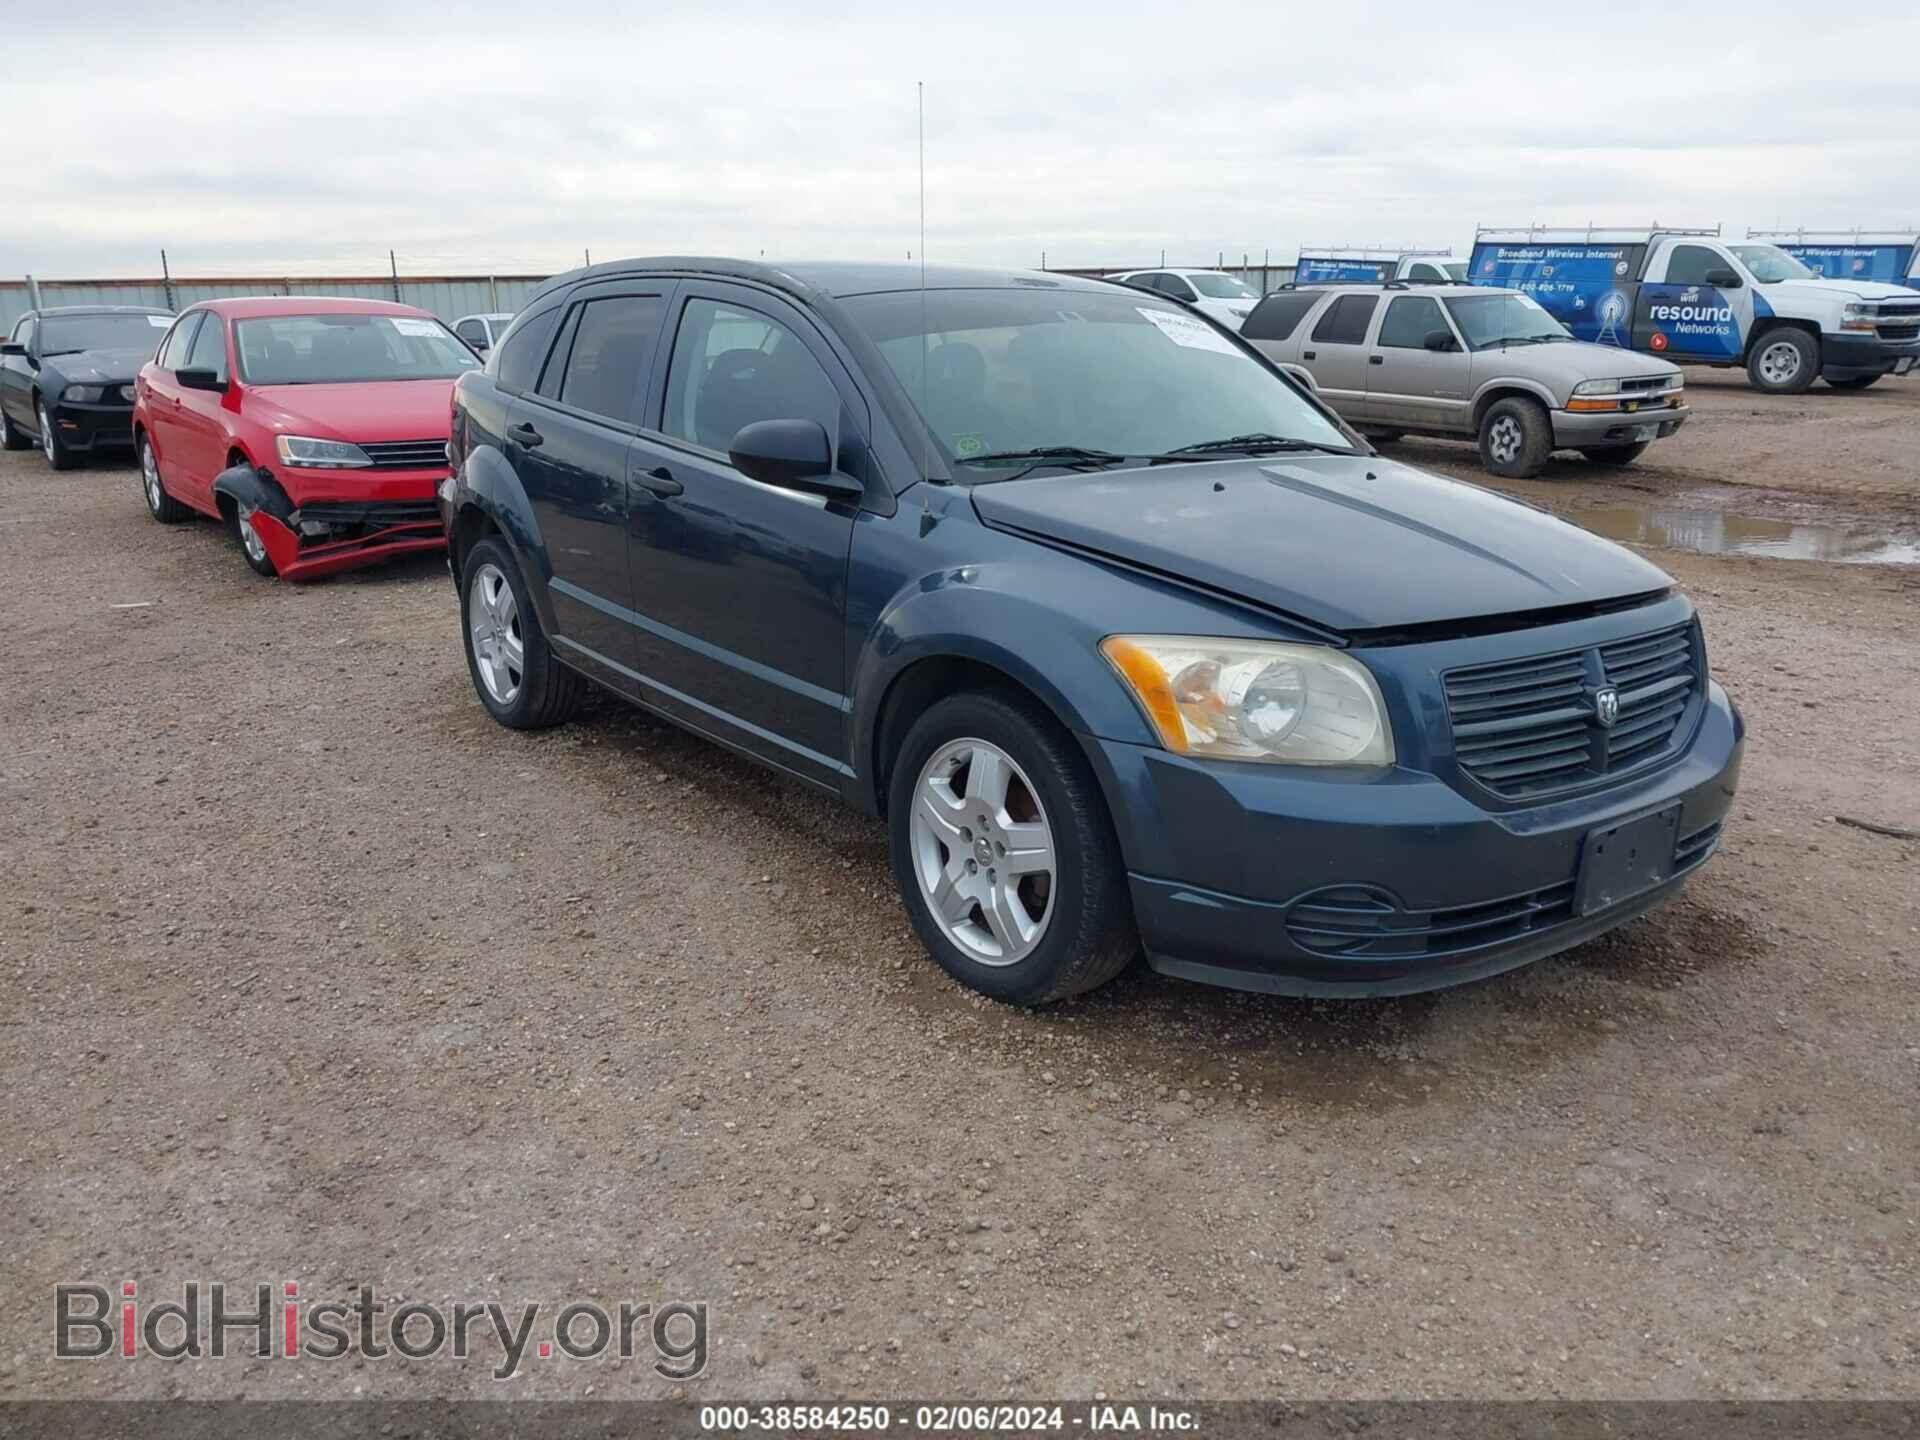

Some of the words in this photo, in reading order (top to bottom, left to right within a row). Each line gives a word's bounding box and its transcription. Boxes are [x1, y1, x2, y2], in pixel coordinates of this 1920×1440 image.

[1497, 247, 1545, 259] Broadband
[1546, 249, 1584, 259] Wireless
[1586, 249, 1624, 259] Internet
[1649, 303, 1733, 322] resound
[1675, 321, 1731, 336] Networks
